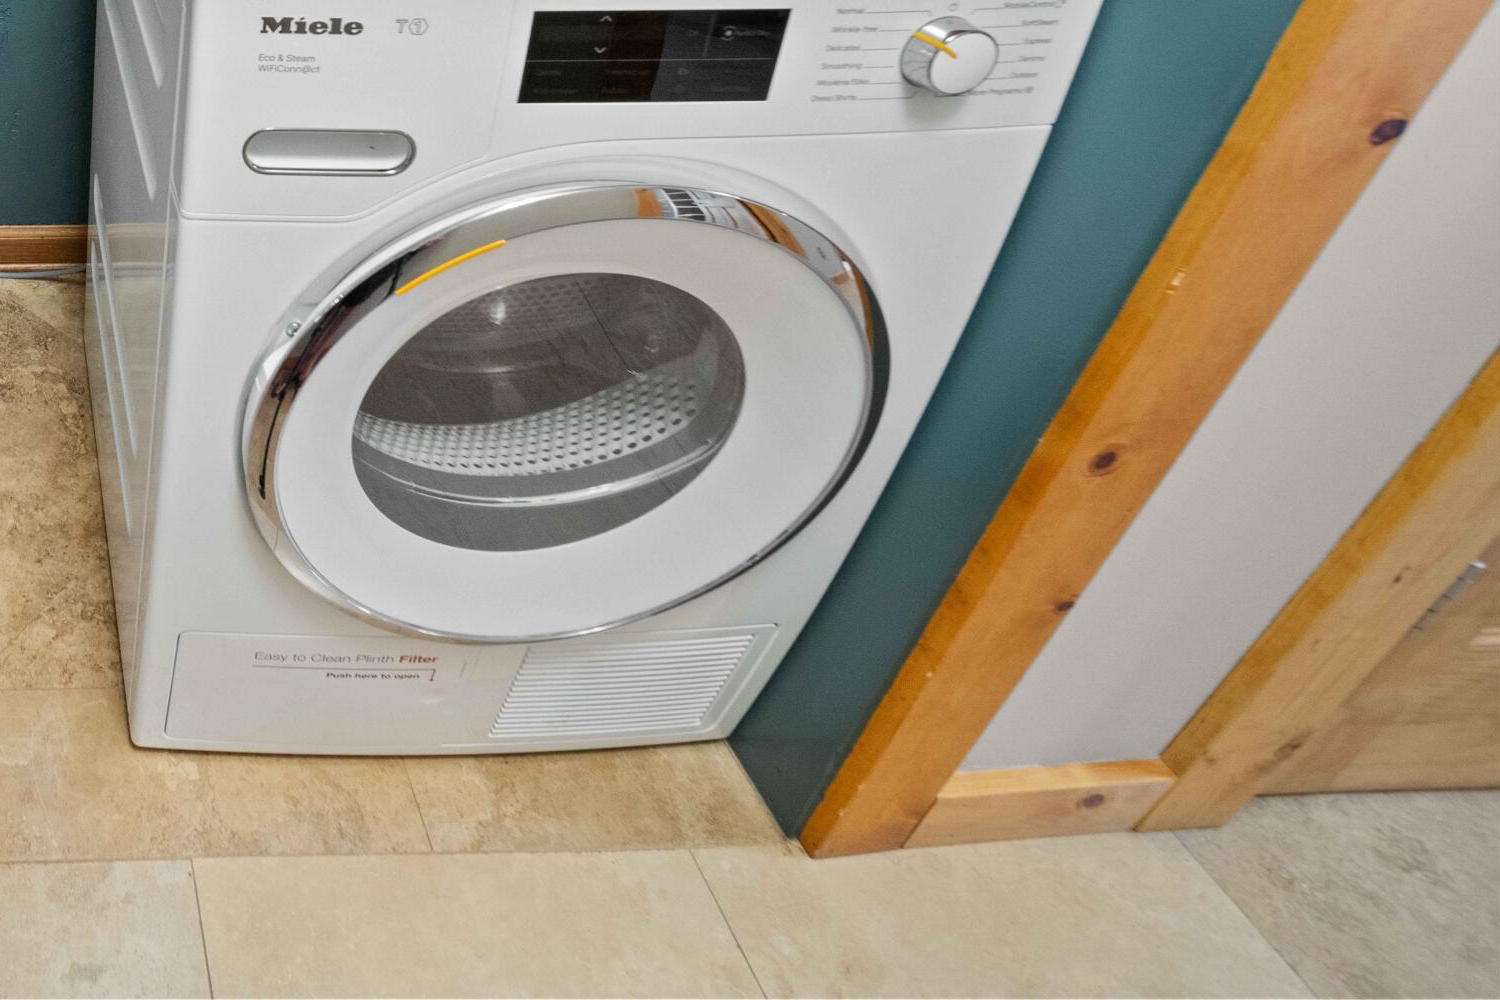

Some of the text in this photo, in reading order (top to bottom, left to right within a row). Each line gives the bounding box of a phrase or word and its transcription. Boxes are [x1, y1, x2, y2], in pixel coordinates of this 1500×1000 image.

[260, 16, 364, 36] Miele
[257, 54, 276, 63] Eco
[285, 54, 316, 63] Steam
[253, 651, 439, 664] Easy to Clean Plinth Filter
[325, 672, 352, 680] Push
[354, 672, 378, 680] here
[393, 673, 421, 681] open
